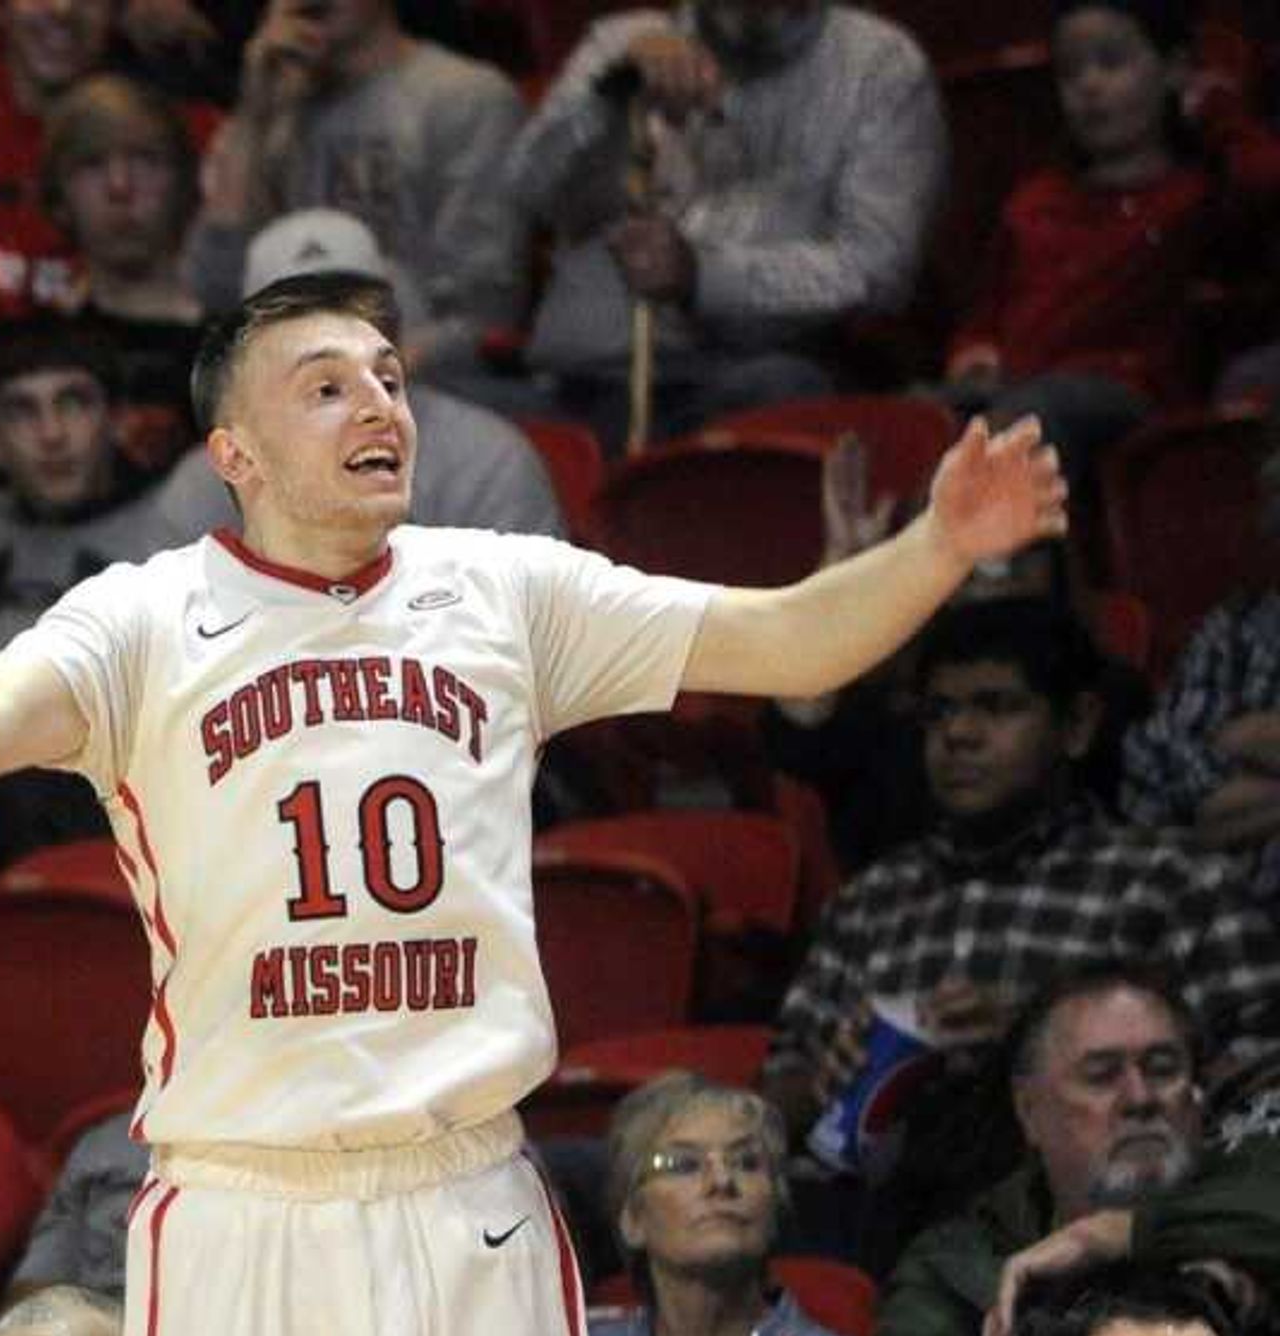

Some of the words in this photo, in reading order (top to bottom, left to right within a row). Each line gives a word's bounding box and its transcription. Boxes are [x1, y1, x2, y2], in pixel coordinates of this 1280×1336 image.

[201, 656, 487, 786] SOUTHEAST
[277, 774, 445, 922] 10
[249, 937, 477, 1019] MISSOURI
